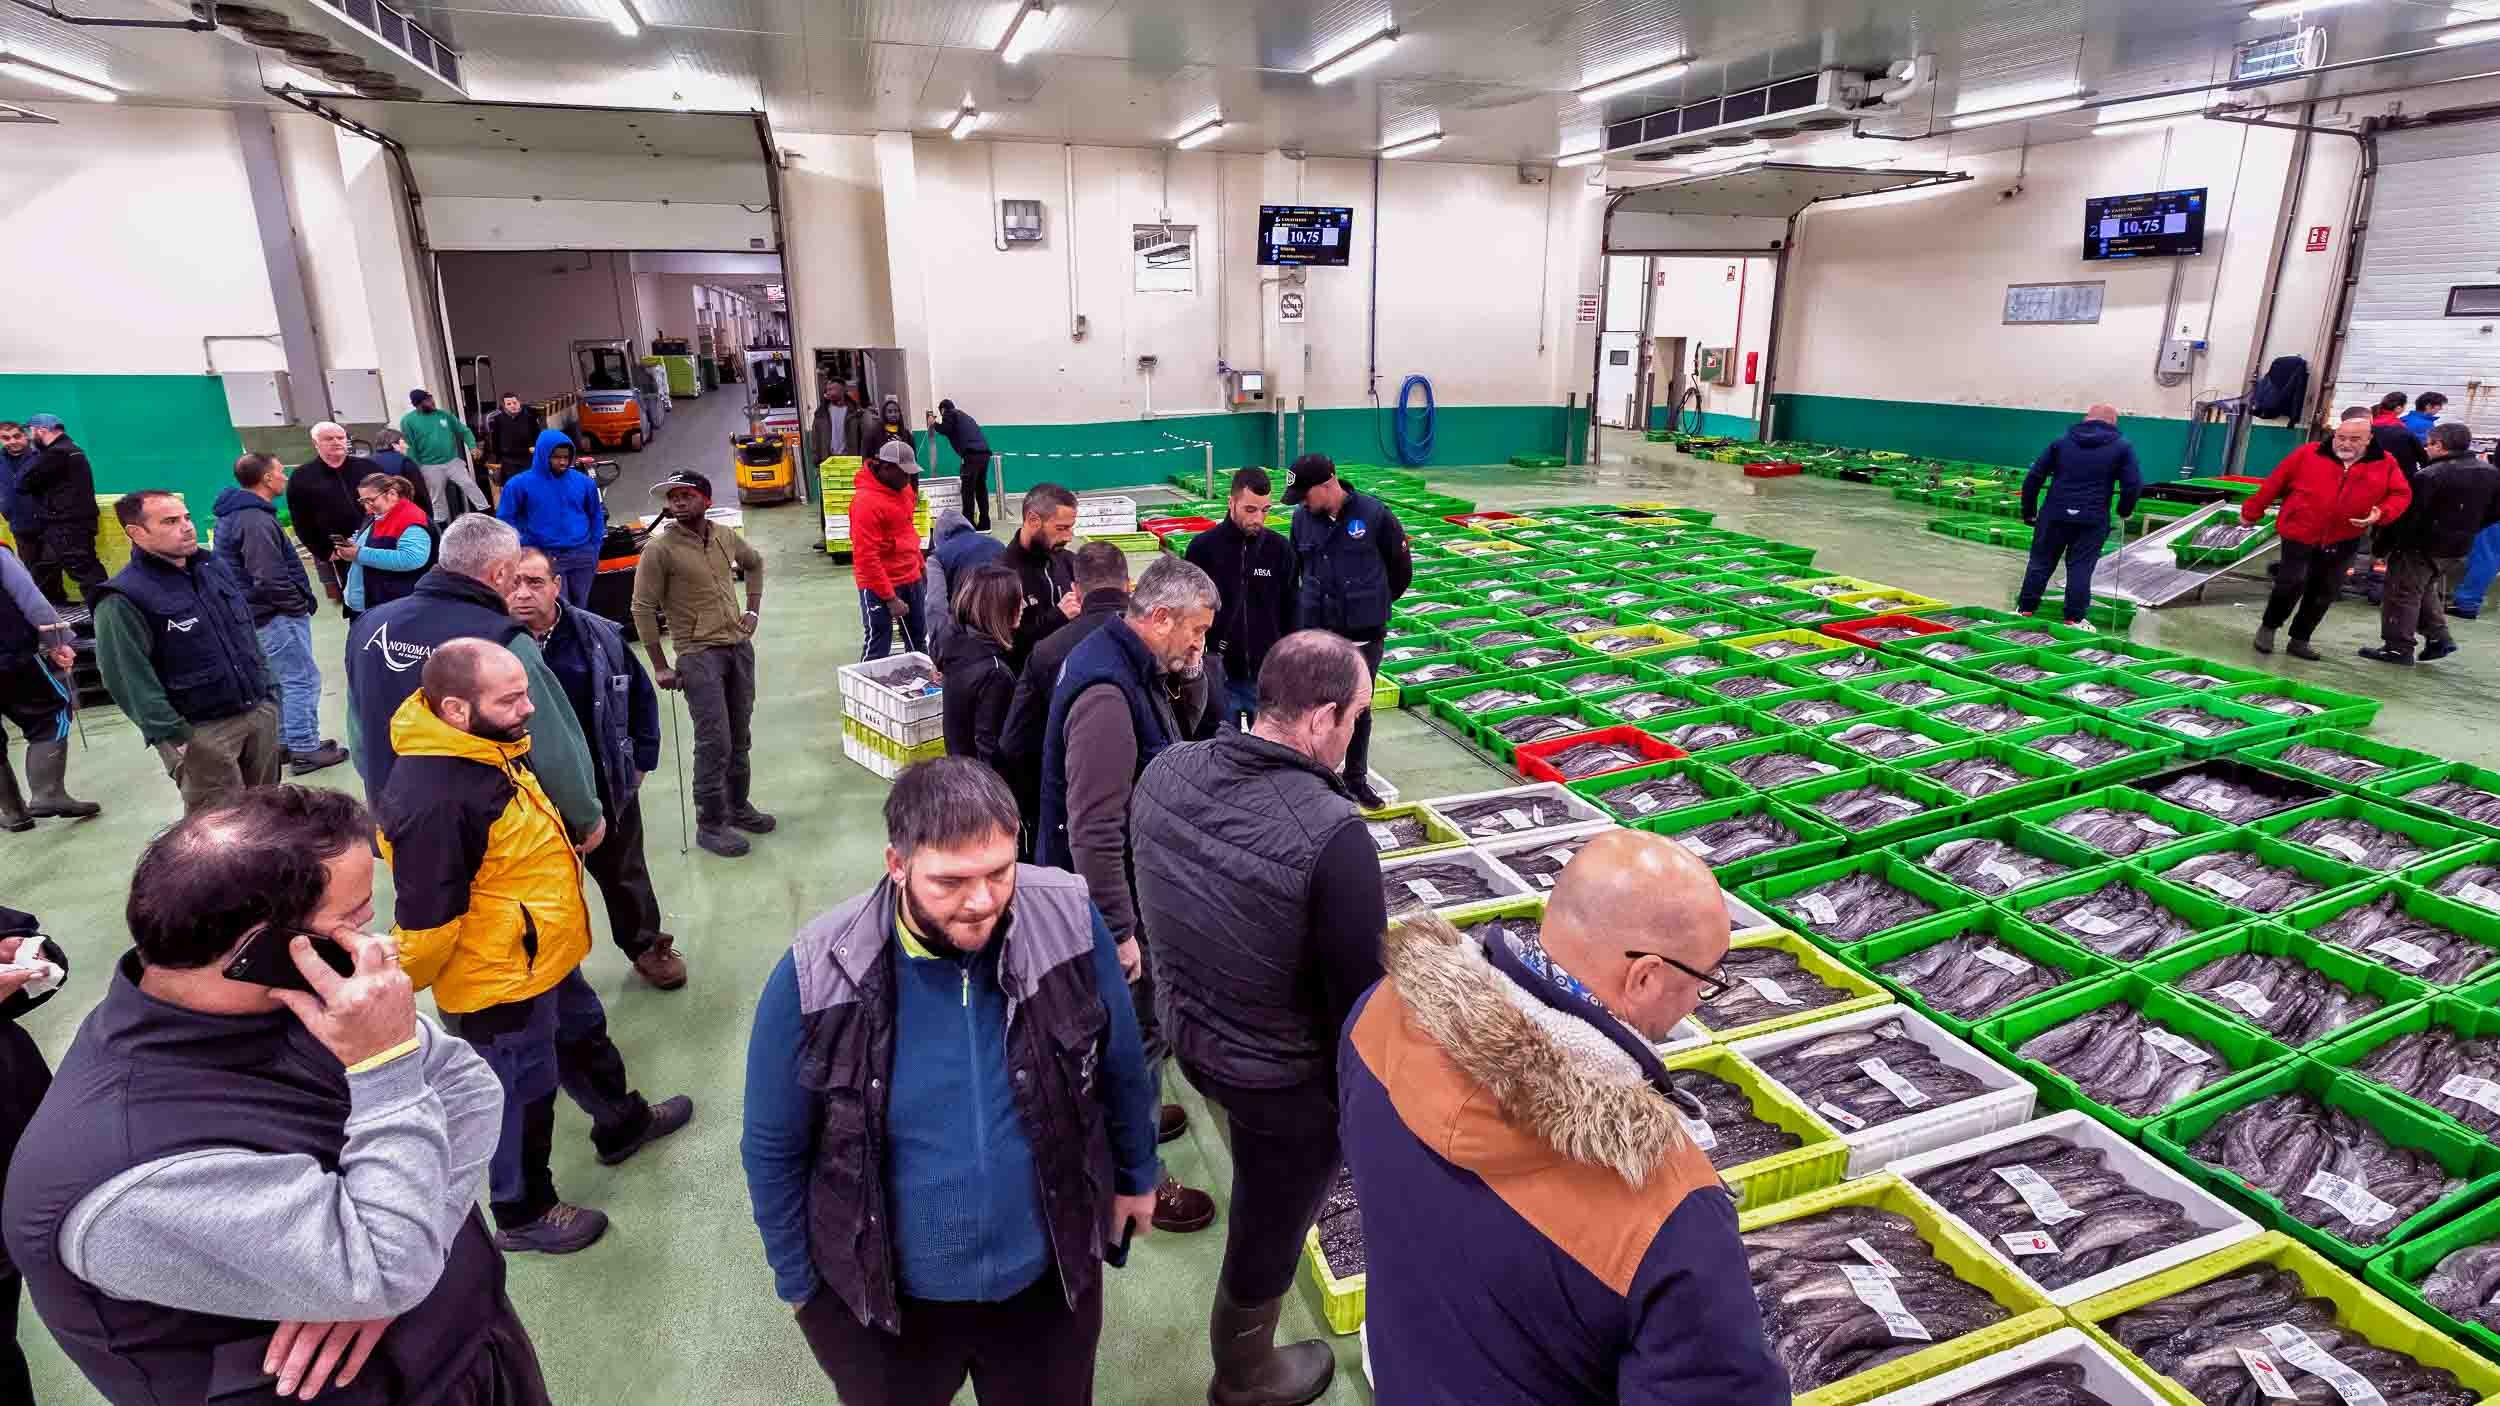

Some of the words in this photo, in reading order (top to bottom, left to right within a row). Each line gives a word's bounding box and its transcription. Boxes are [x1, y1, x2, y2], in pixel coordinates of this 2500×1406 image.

[1263, 231, 1269, 245] 1
[1290, 231, 1320, 244] 10,75
[2088, 225, 2099, 238] 2
[2170, 351, 2177, 361] 2
[1253, 568, 1272, 577] ABSA
